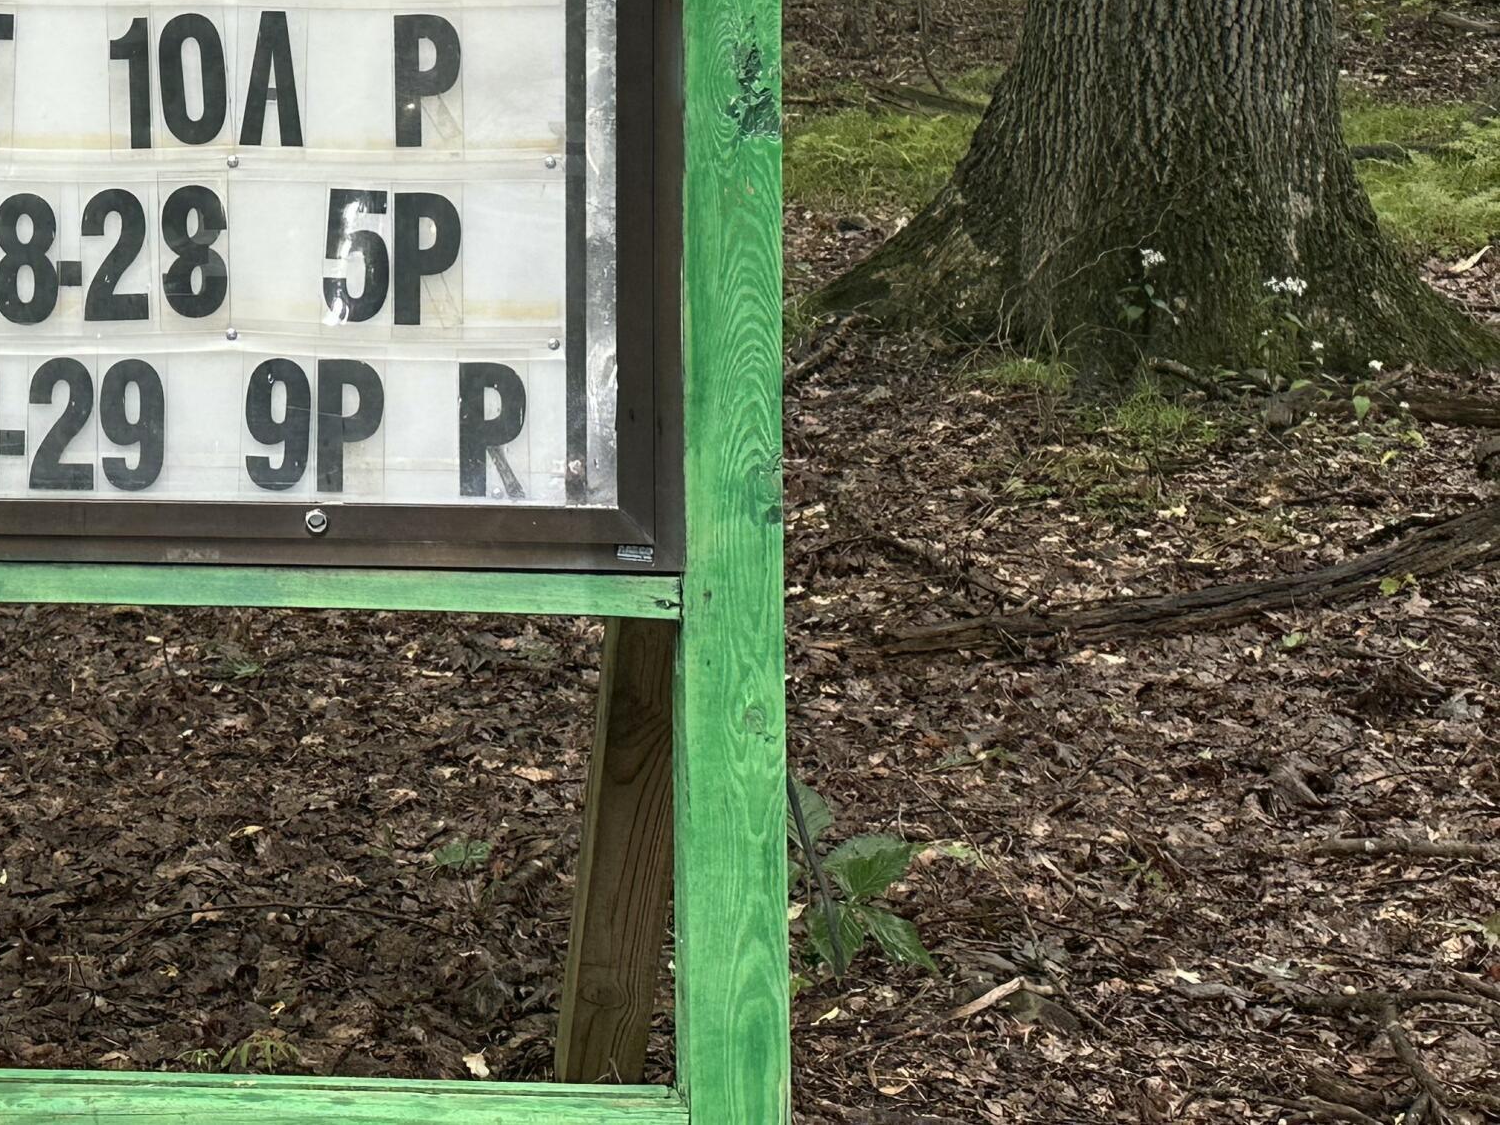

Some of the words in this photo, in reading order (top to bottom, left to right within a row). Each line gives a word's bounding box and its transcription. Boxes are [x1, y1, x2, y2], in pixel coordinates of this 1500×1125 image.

[109, 10, 303, 149] 10A
[394, 13, 461, 148] P
[323, 188, 462, 326] 5P
[245, 358, 385, 493] 9P
[459, 362, 527, 498] R
